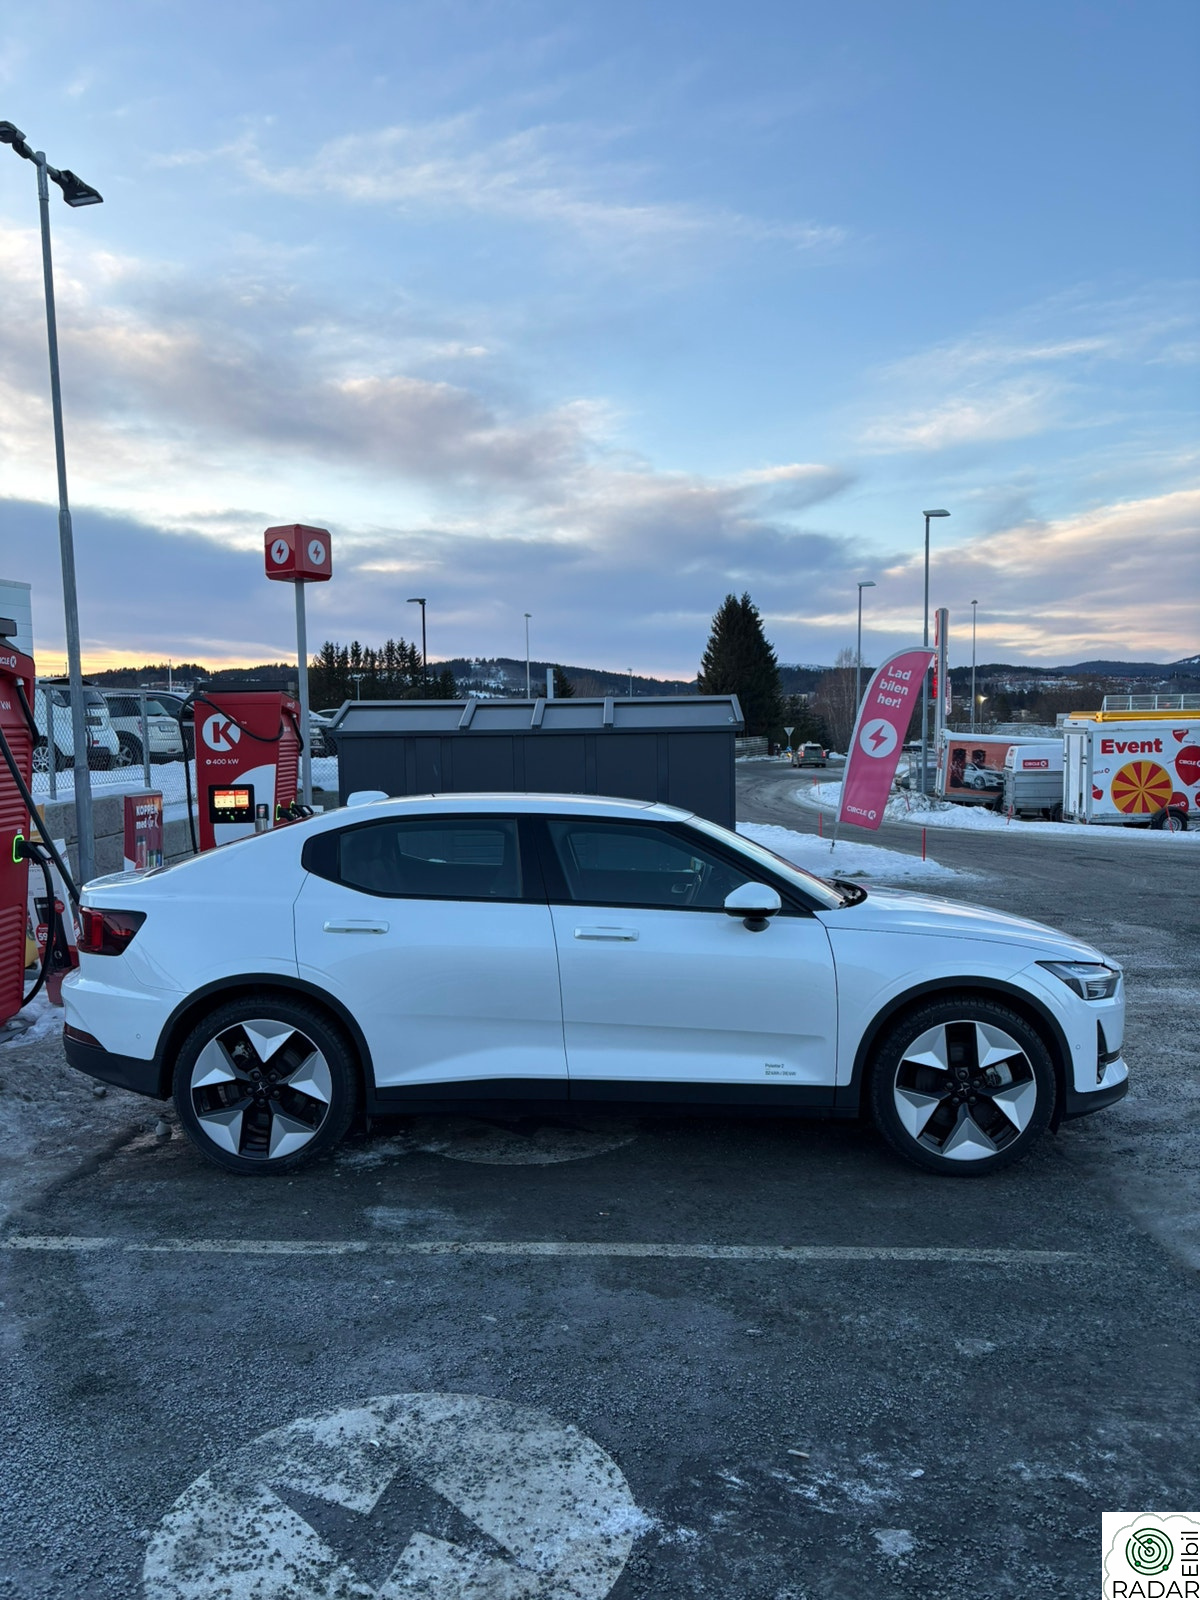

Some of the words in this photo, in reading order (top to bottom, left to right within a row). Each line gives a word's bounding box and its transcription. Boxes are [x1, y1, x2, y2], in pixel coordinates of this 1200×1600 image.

[887, 666, 912, 681] Lad
[879, 678, 909, 696] bilen
[876, 693, 902, 708] her!
[1101, 738, 1163, 754] Event
[846, 805, 867, 816] CIRCLE
[868, 810, 876, 820] K
